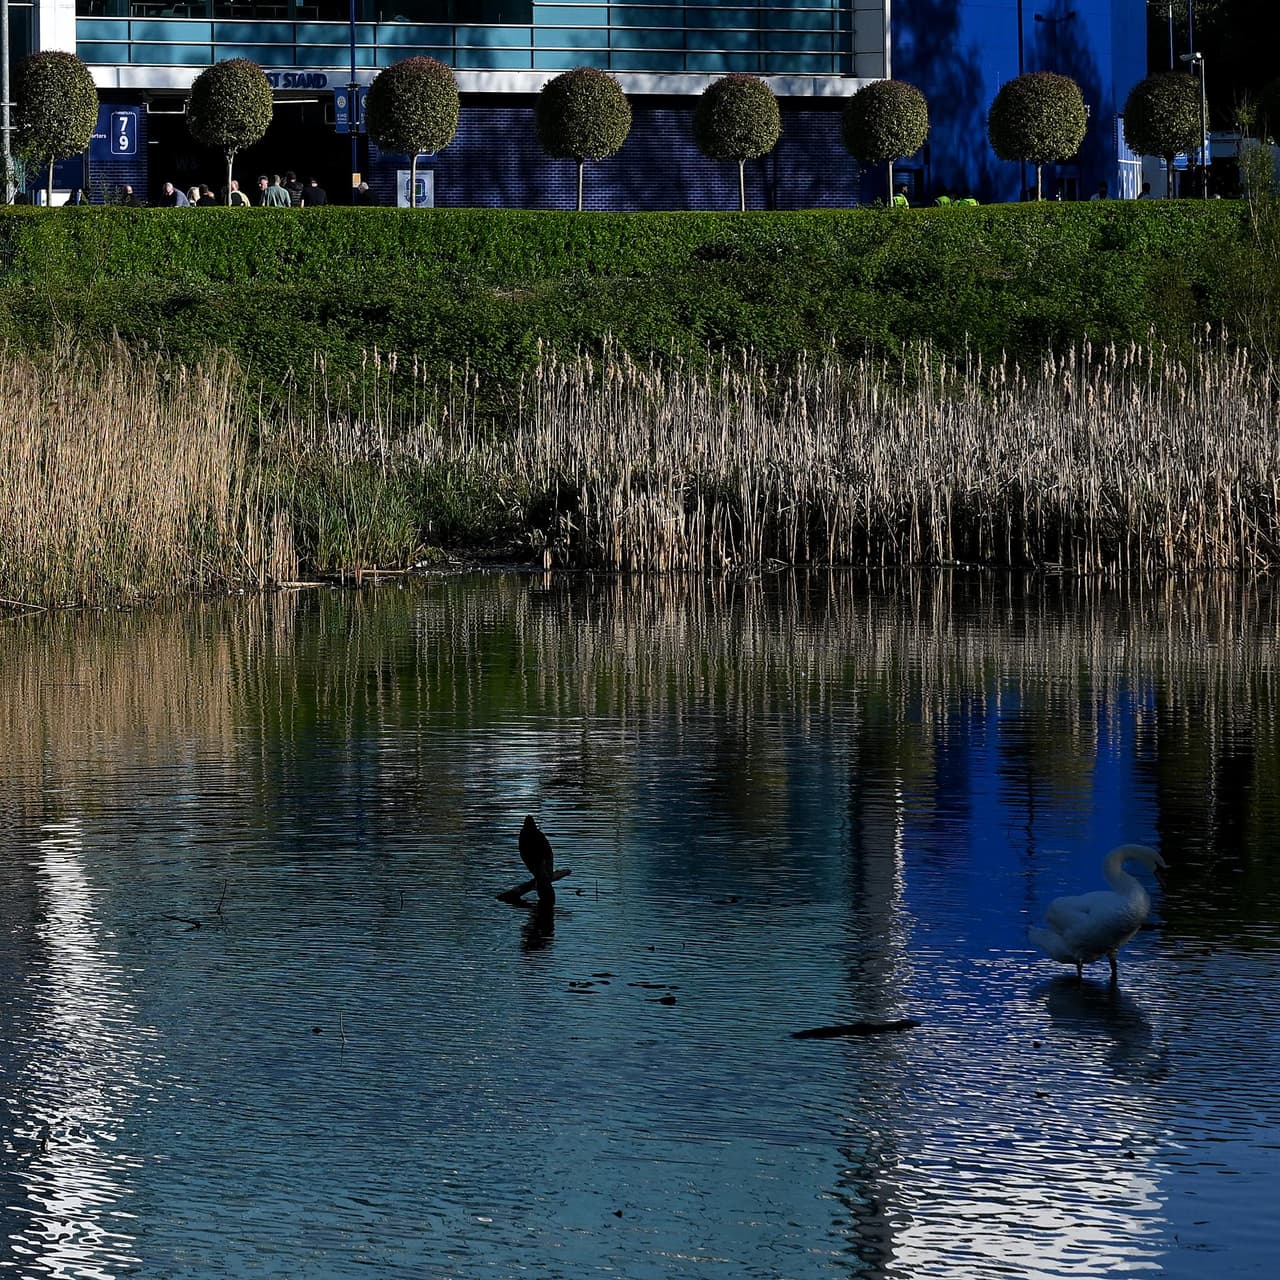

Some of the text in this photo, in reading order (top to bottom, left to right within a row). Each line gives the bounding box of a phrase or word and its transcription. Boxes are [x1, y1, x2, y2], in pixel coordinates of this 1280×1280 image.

[282, 72, 328, 89] STAND
[119, 116, 129, 132] 7
[119, 135, 129, 151] 9
